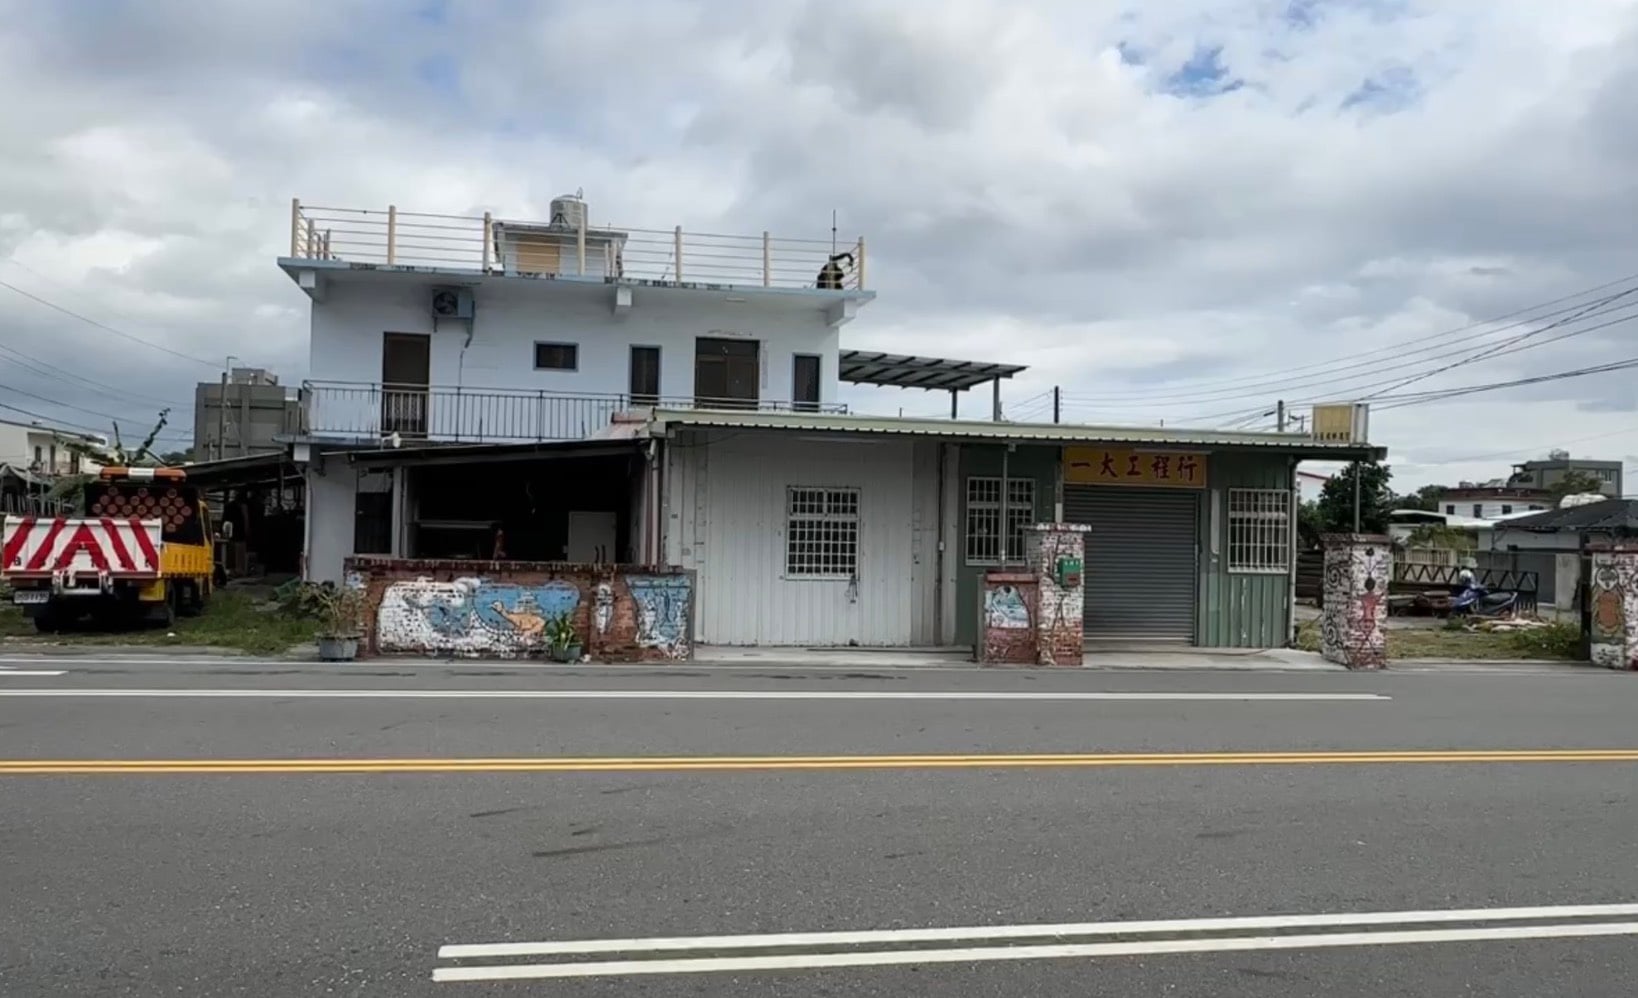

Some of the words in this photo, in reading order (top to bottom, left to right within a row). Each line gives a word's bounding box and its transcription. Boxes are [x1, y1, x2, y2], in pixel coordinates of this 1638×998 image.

[1071, 452, 1198, 481] 一大工程行
